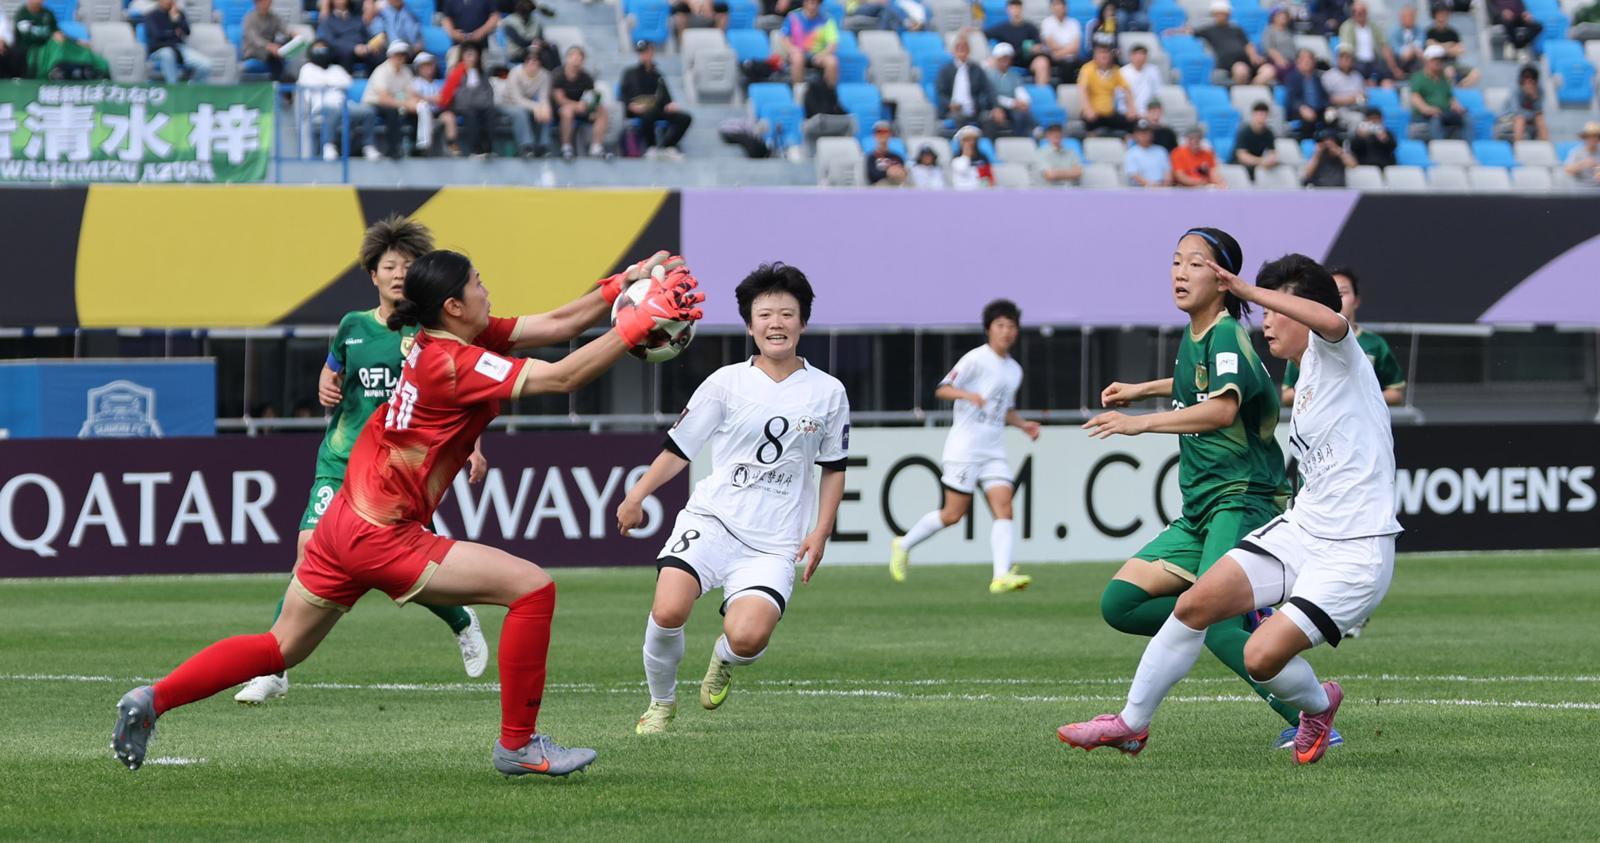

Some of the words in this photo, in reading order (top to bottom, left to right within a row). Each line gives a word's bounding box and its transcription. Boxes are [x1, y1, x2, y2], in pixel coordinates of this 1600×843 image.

[0, 102, 261, 164] 清水梓
[756, 415, 789, 465] 8
[0, 470, 281, 557] QATAR
[314, 485, 334, 516] 3
[433, 464, 664, 540] WAYS
[1395, 465, 1597, 515] WOMEN'S
[671, 528, 701, 553] 8
